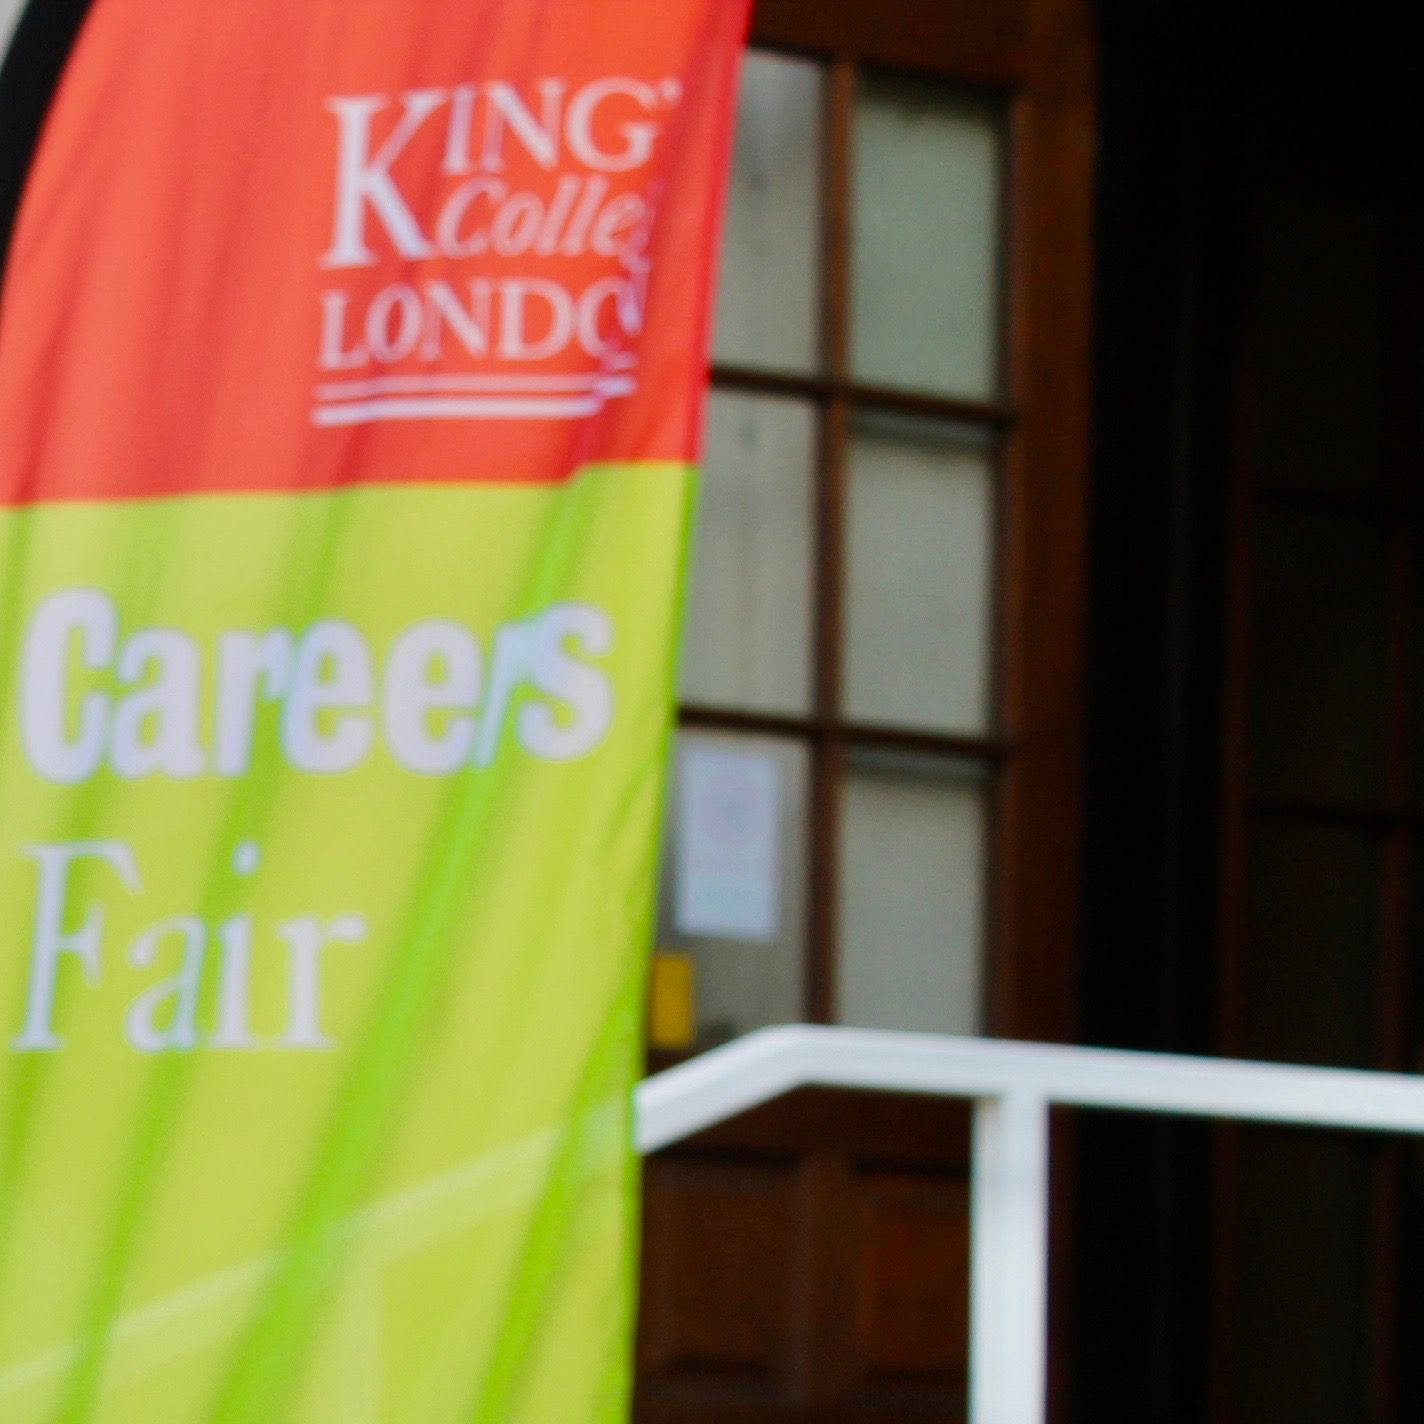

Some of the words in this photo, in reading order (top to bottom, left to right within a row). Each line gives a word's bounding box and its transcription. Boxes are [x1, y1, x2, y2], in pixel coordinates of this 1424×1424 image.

[320, 76, 683, 269] KING'
[435, 173, 658, 273] Colle
[318, 275, 644, 370] LONDO
[18, 586, 614, 785] Careers
[8, 840, 369, 1053] Fair
